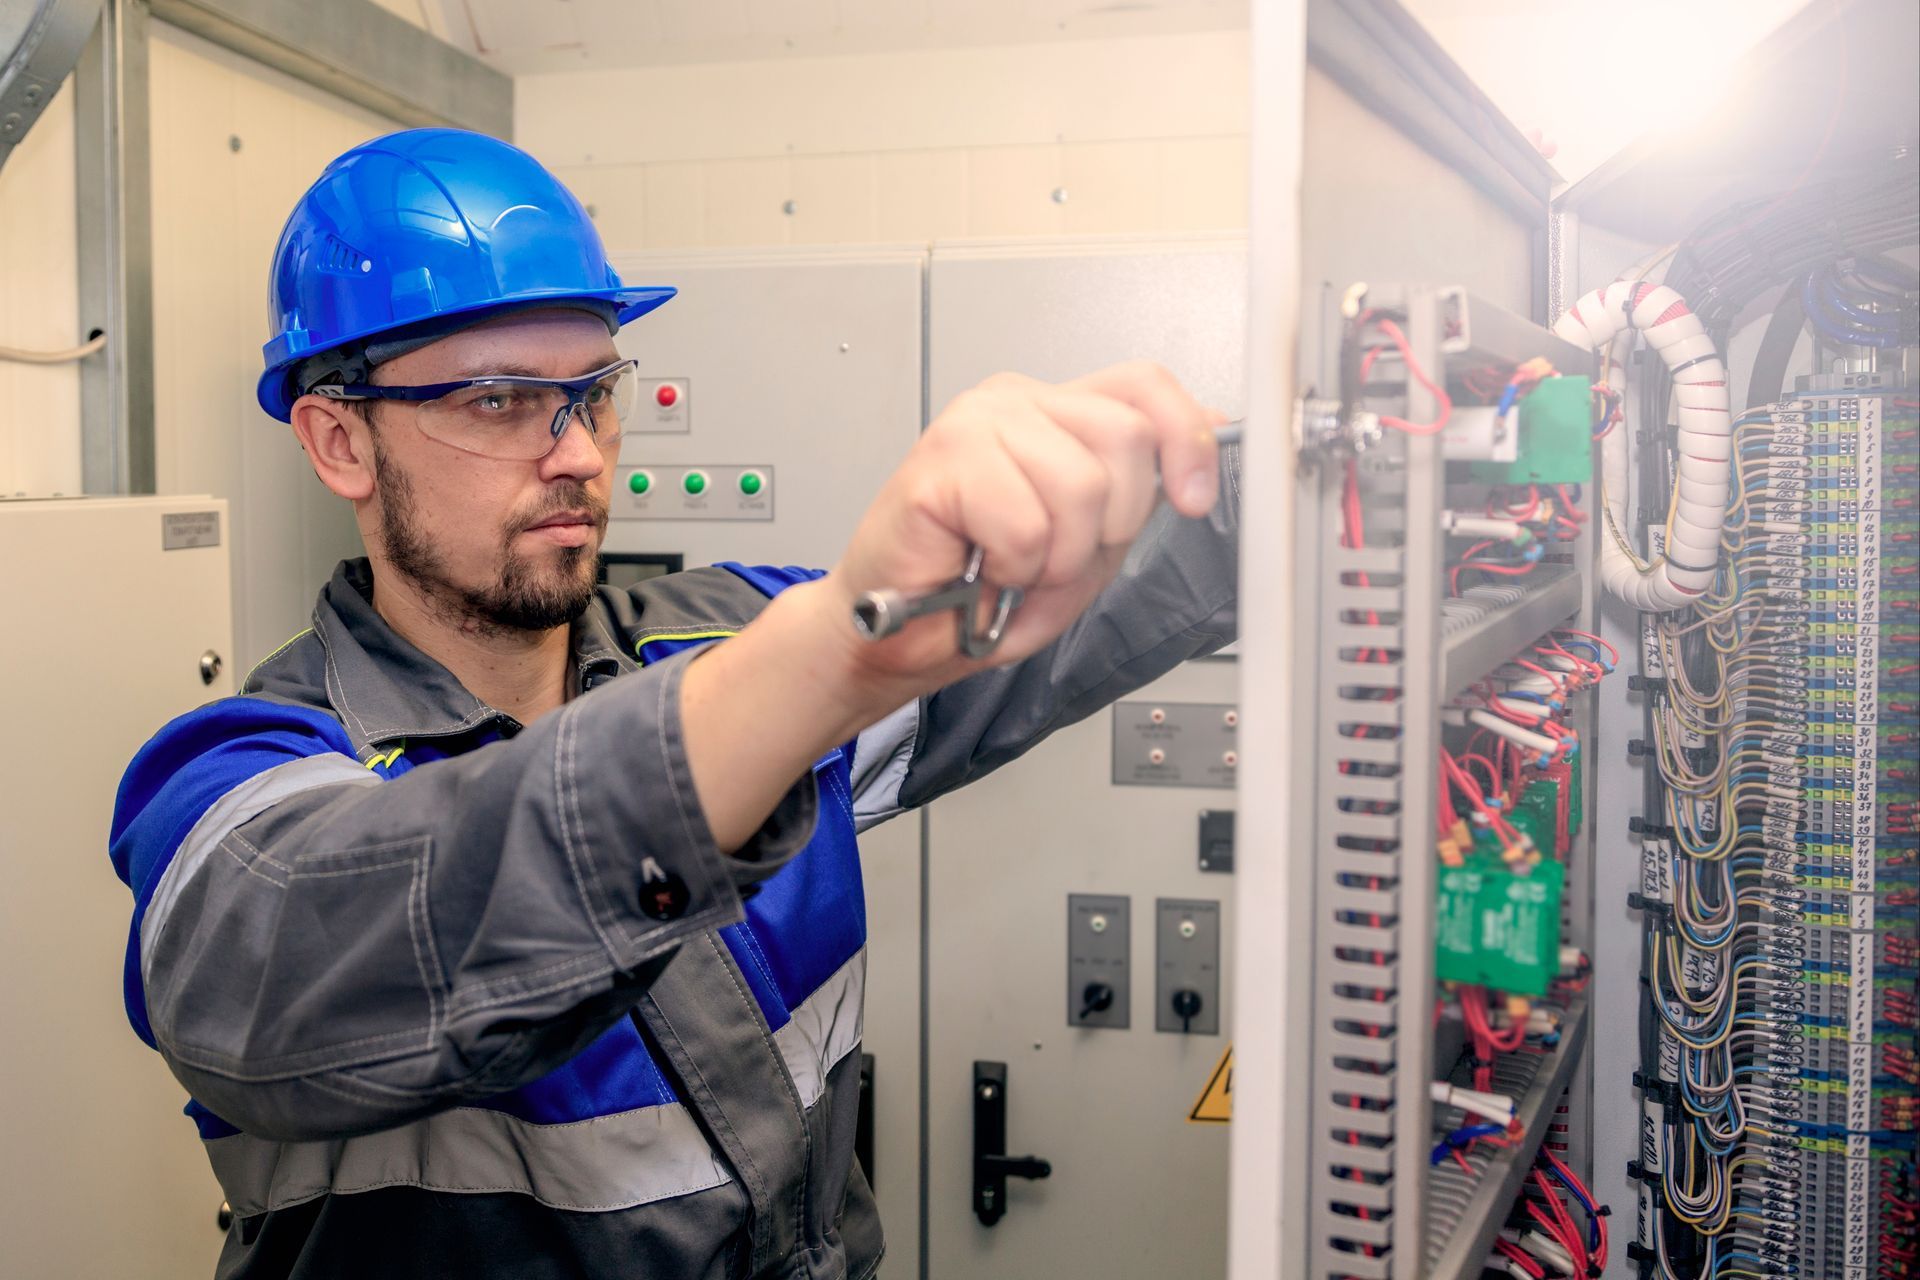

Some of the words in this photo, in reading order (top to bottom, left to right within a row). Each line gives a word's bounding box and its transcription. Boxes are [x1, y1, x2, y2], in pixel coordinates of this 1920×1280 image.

[1862, 500, 1873, 509] 10
[1865, 513, 1874, 521] 11
[1864, 524, 1874, 533] 12
[1864, 534, 1874, 543] 13
[1865, 545, 1875, 556] 14
[1863, 557, 1877, 567] 15
[1863, 567, 1874, 577] 16
[1863, 580, 1875, 590] 17
[1862, 590, 1874, 600] 18
[1863, 600, 1874, 611] 19
[1861, 612, 1874, 622] 20
[1860, 626, 1871, 634] 21
[1860, 637, 1873, 647] 22
[1862, 648, 1873, 658] 23
[1861, 658, 1873, 668] 24
[1860, 670, 1874, 679] 25
[1860, 682, 1872, 690] 26
[1860, 692, 1872, 702] 27
[1859, 703, 1874, 712] 28
[1860, 713, 1875, 722] 29
[1859, 727, 1871, 737] 30
[1857, 738, 1870, 747] 31
[1860, 749, 1872, 758] 32
[1859, 760, 1871, 770] 33
[1857, 771, 1870, 781] 34
[1858, 783, 1873, 791] 35
[1857, 793, 1869, 801] 36
[1858, 802, 1872, 811] 37
[1857, 816, 1871, 824] 38
[1857, 826, 1870, 835] 39
[1858, 838, 1870, 847] 40
[1857, 847, 1869, 857] 41
[1858, 859, 1869, 868] 42
[1857, 870, 1869, 880] 43
[1857, 882, 1870, 891] 44
